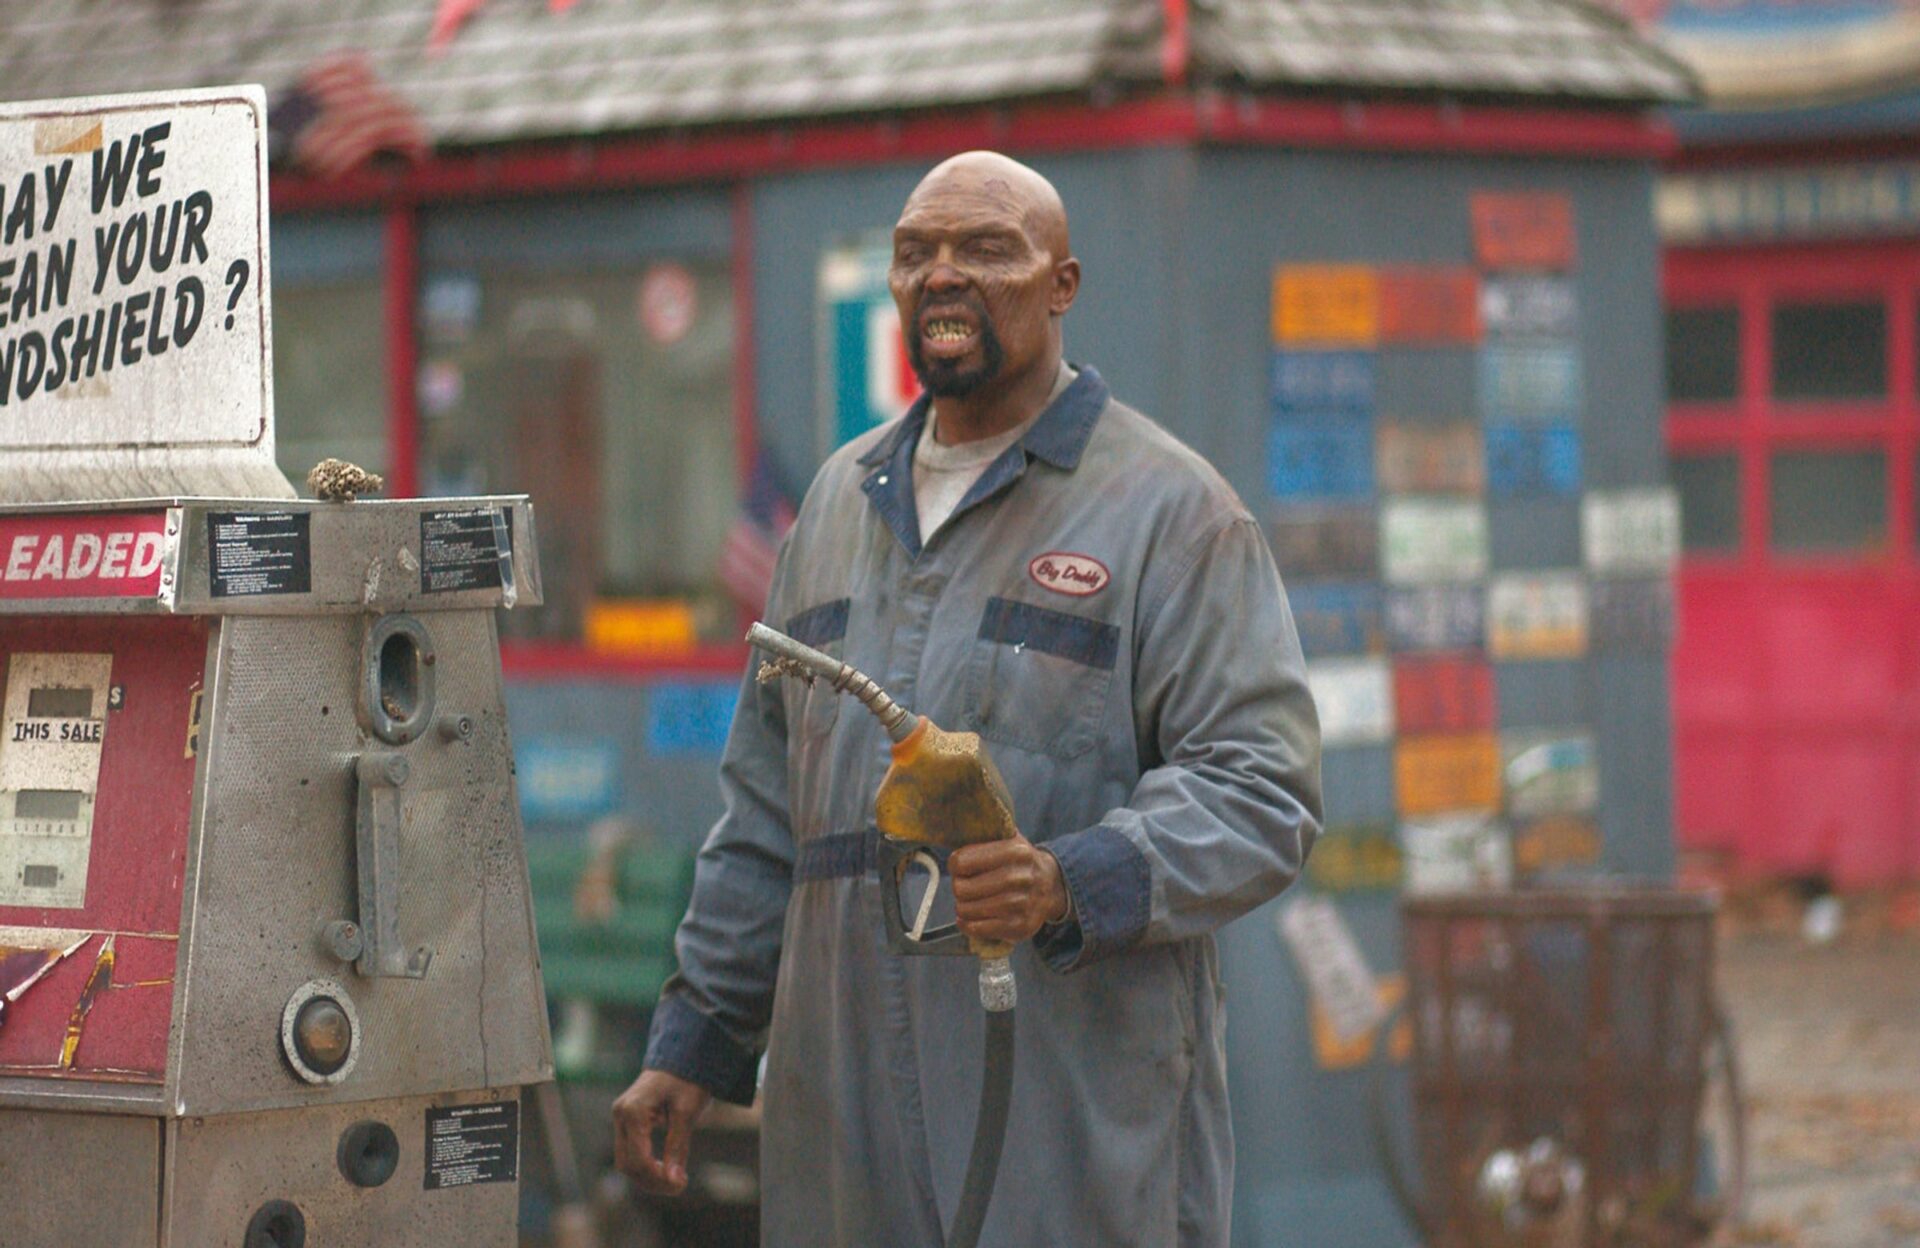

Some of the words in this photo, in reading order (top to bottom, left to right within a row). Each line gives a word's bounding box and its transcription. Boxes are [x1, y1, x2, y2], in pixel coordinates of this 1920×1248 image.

[0, 158, 72, 245] AY
[91, 121, 171, 215] WE
[93, 190, 213, 296] YOUR
[0, 531, 165, 582] EADED
[1062, 565, 1100, 587] Daddy
[14, 722, 50, 741] THIS
[60, 722, 101, 742] SALE
